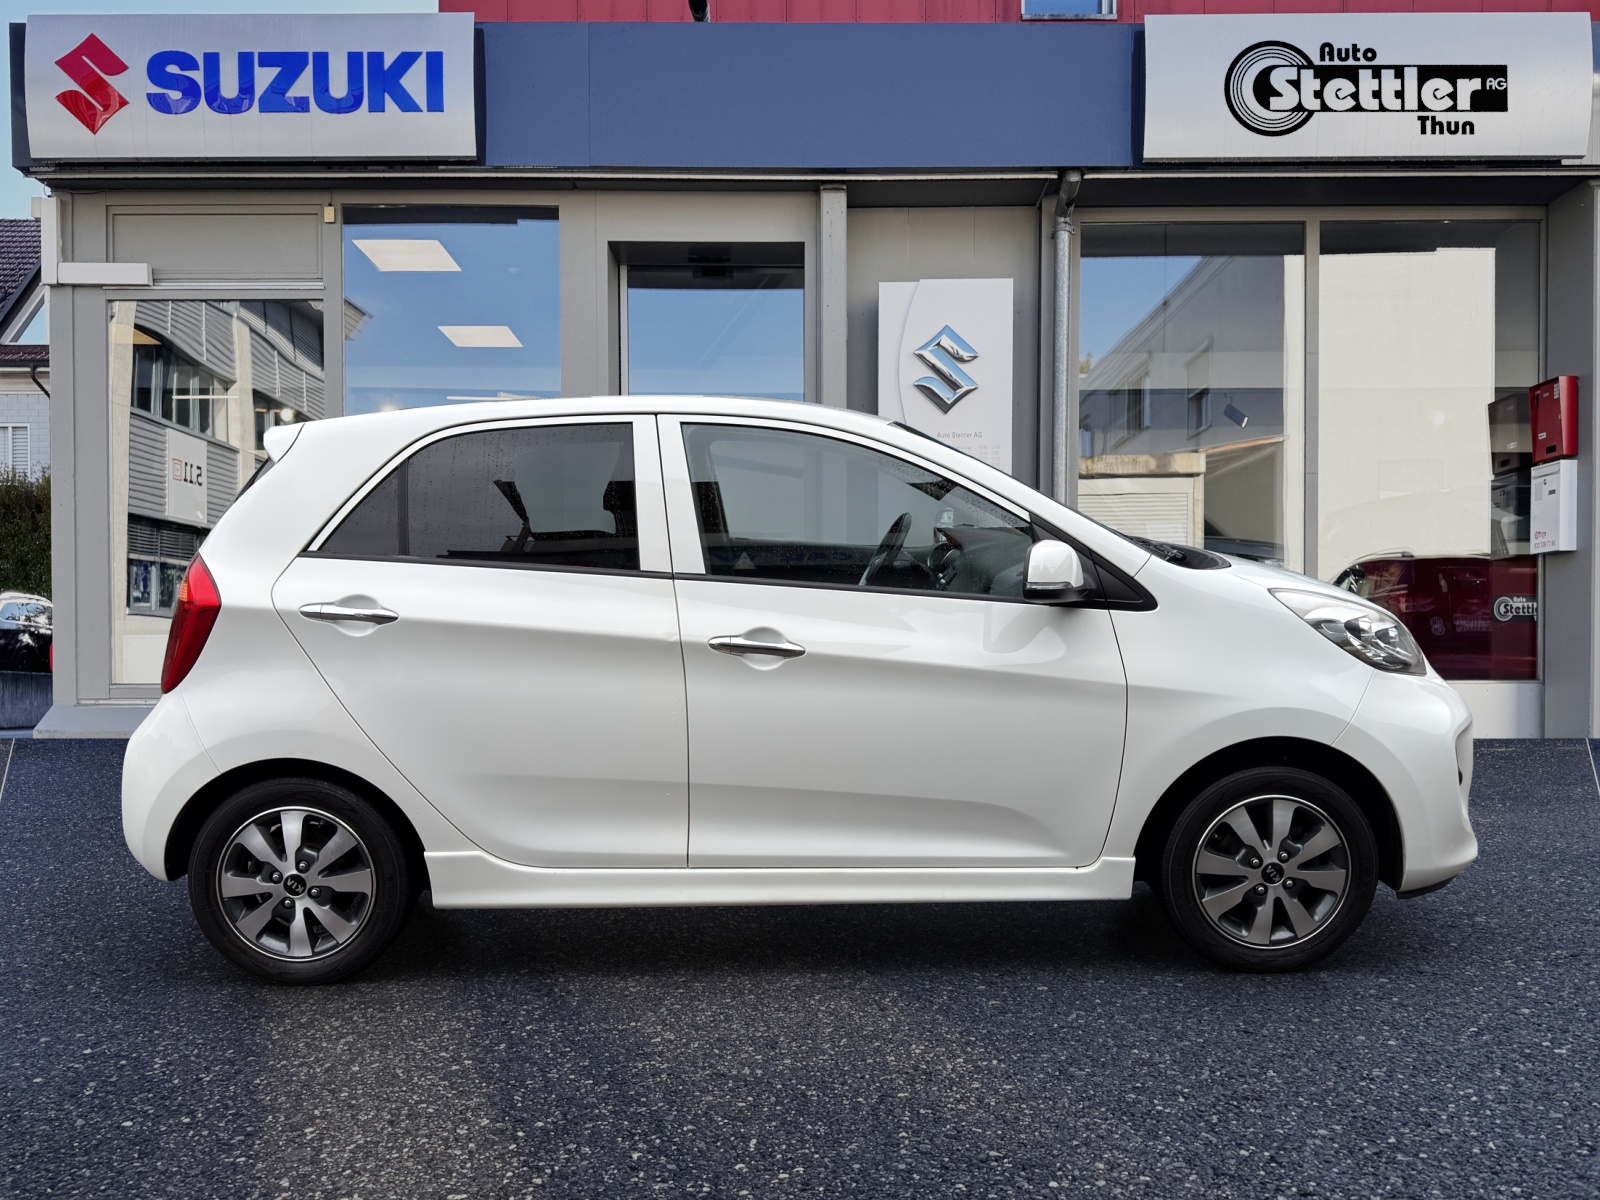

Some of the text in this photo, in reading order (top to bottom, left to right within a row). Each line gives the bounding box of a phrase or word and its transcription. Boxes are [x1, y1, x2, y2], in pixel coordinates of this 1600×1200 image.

[1319, 42, 1377, 62] Auto
[146, 50, 444, 114] SUZUKI
[1269, 66, 1507, 111] Stettler AG
[1417, 115, 1475, 135] Thun
[1266, 865, 1281, 882] KIA
[287, 877, 304, 893] KIA
